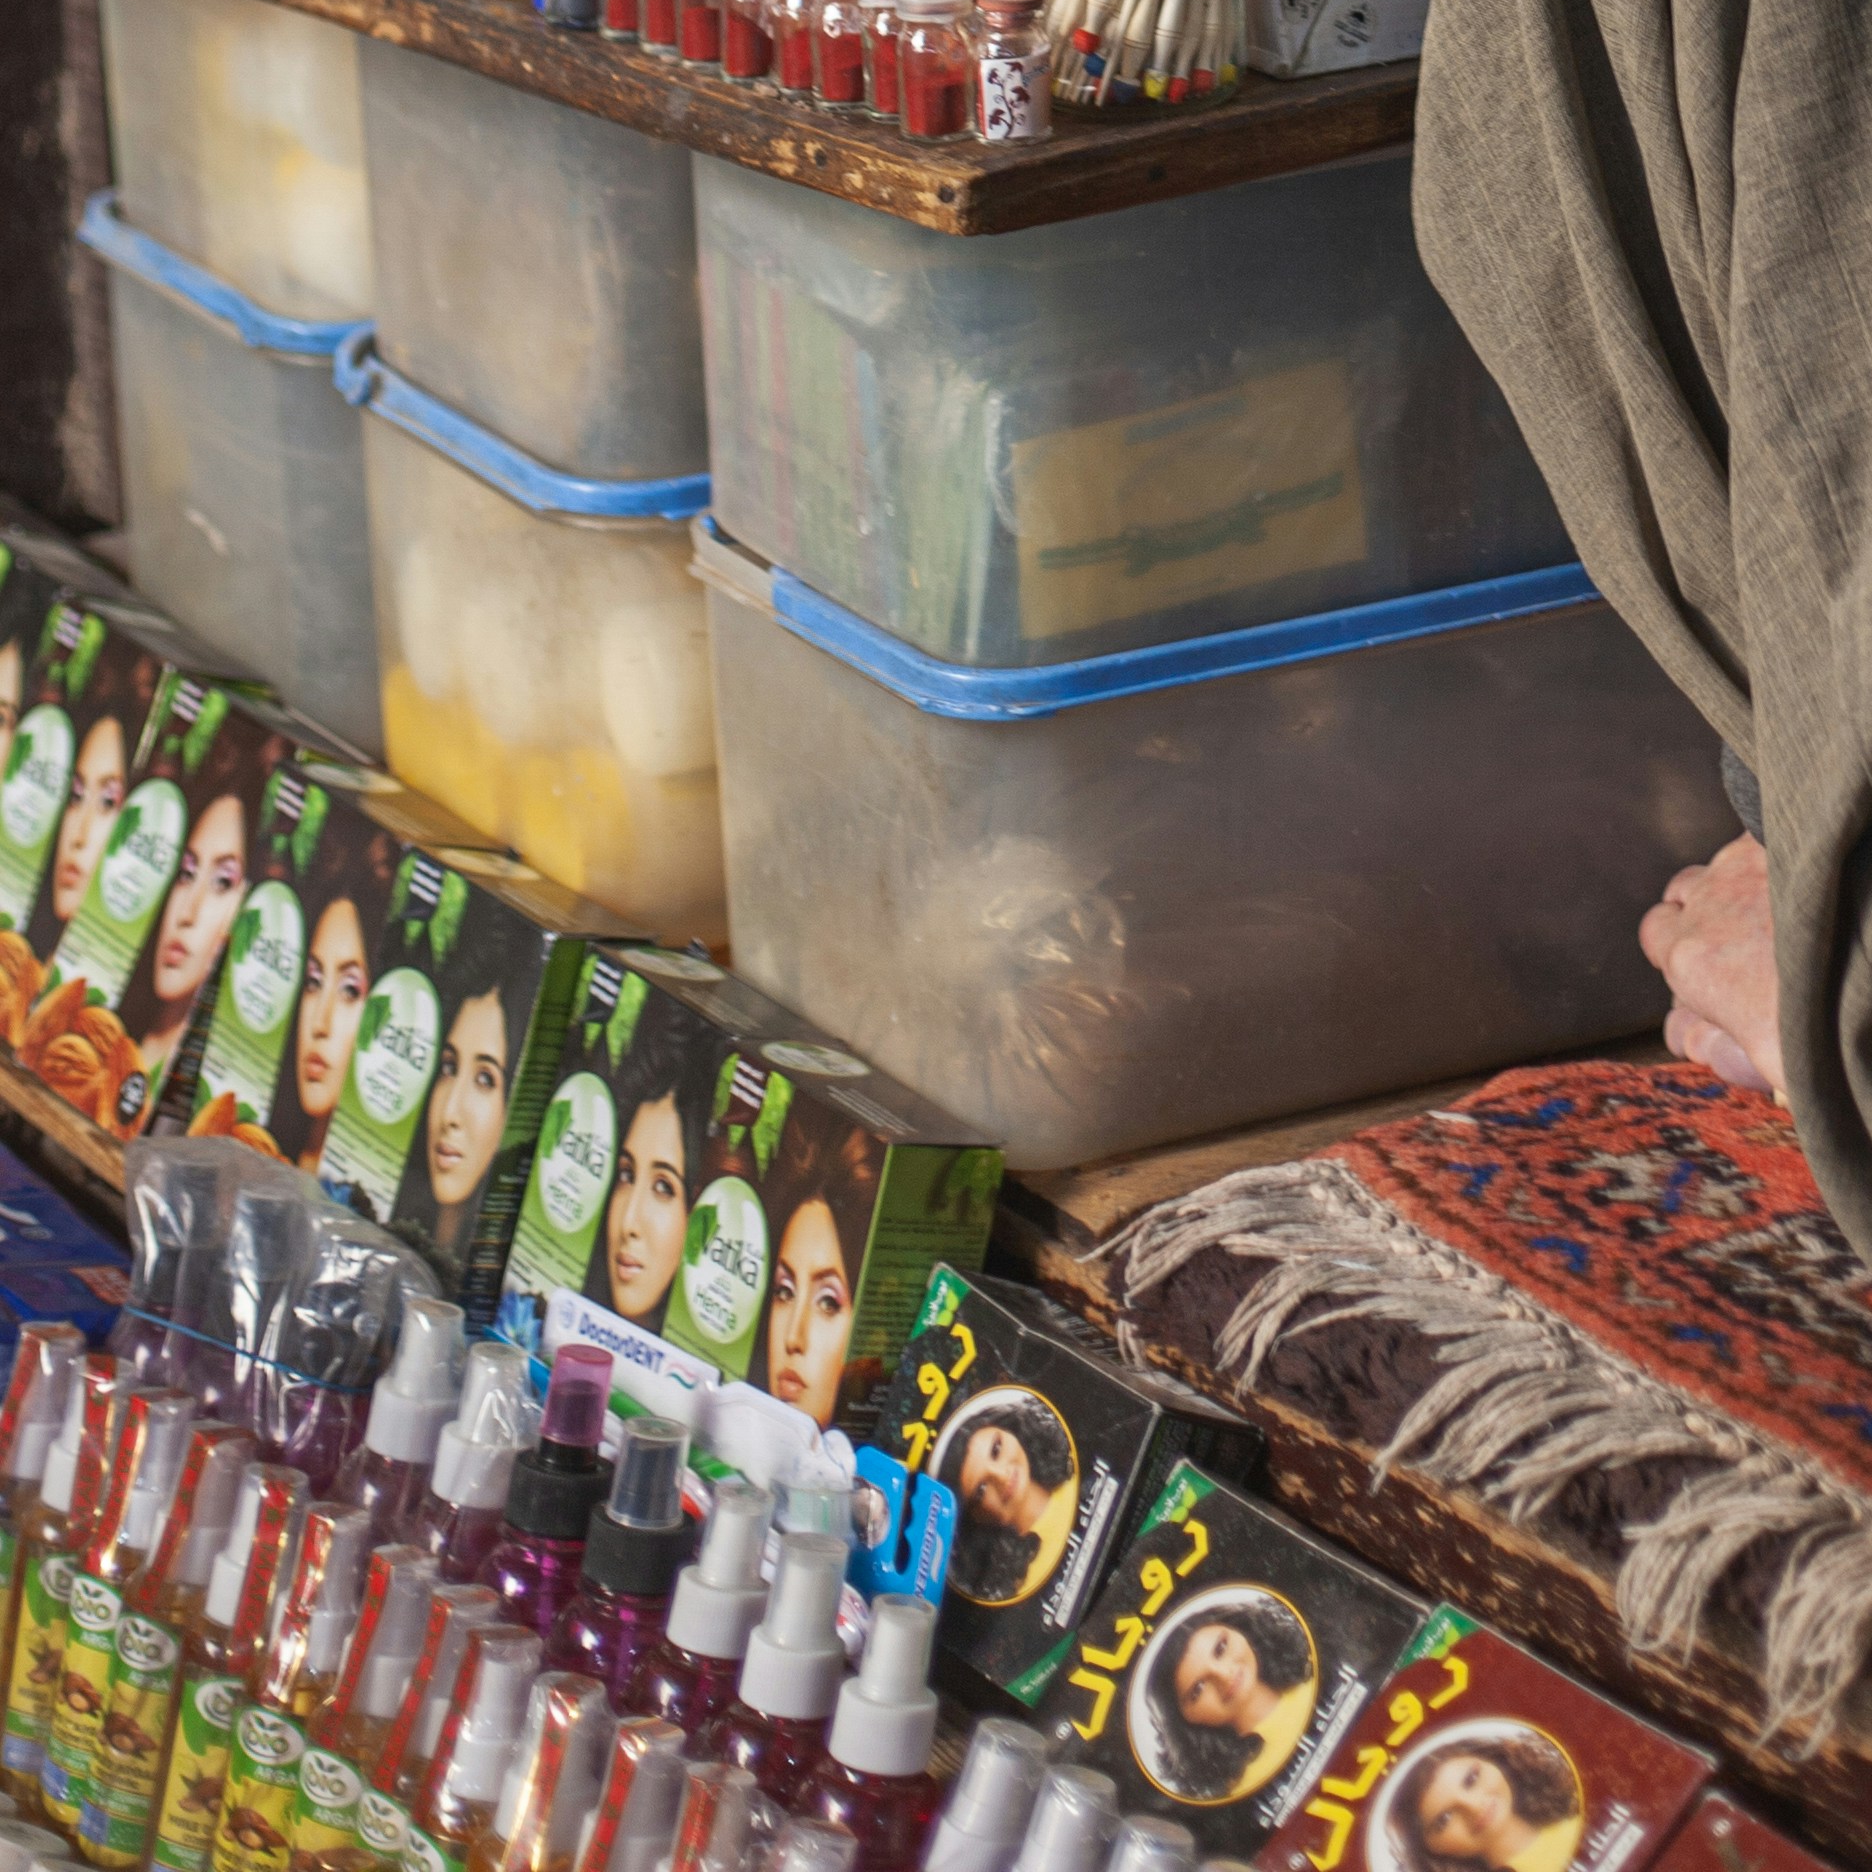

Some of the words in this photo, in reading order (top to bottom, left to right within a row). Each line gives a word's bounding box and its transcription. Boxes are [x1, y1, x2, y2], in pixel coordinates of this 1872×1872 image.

[577, 1310, 667, 1374] DoctorDENT
[1066, 1519, 1210, 1742] رويال
[1303, 1656, 1470, 1872] رويال
